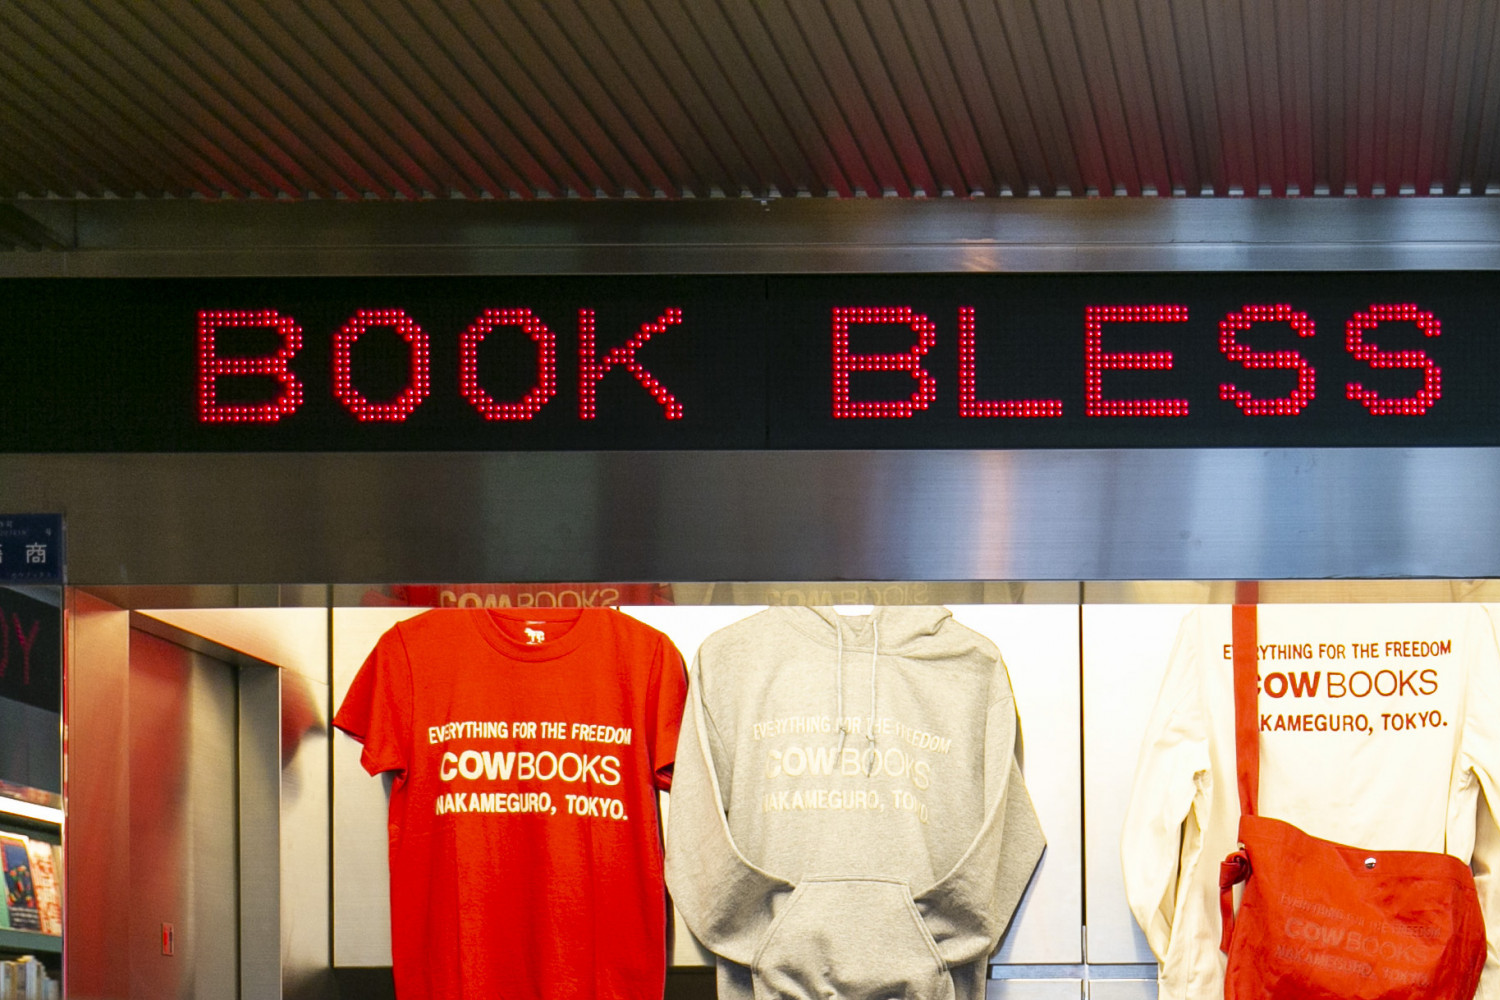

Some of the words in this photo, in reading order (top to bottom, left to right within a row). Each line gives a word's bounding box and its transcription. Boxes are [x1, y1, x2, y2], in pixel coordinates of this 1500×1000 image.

[196, 306, 686, 424] BOOK
[831, 301, 1444, 420] BLESS
[1318, 643, 1346, 660] FOR
[1352, 642, 1379, 659] THE
[1385, 639, 1452, 658] FREEDOM
[1257, 669, 1439, 699] OWBOOKS
[428, 720, 509, 744] EVERYTHING
[511, 721, 538, 739] FOR
[540, 721, 567, 740] THE
[570, 723, 633, 746] FREEDOM
[1381, 710, 1448, 732] TOKYO.
[435, 791, 558, 816] NAKAMEGURO,
[564, 794, 629, 821] TOKYO.
